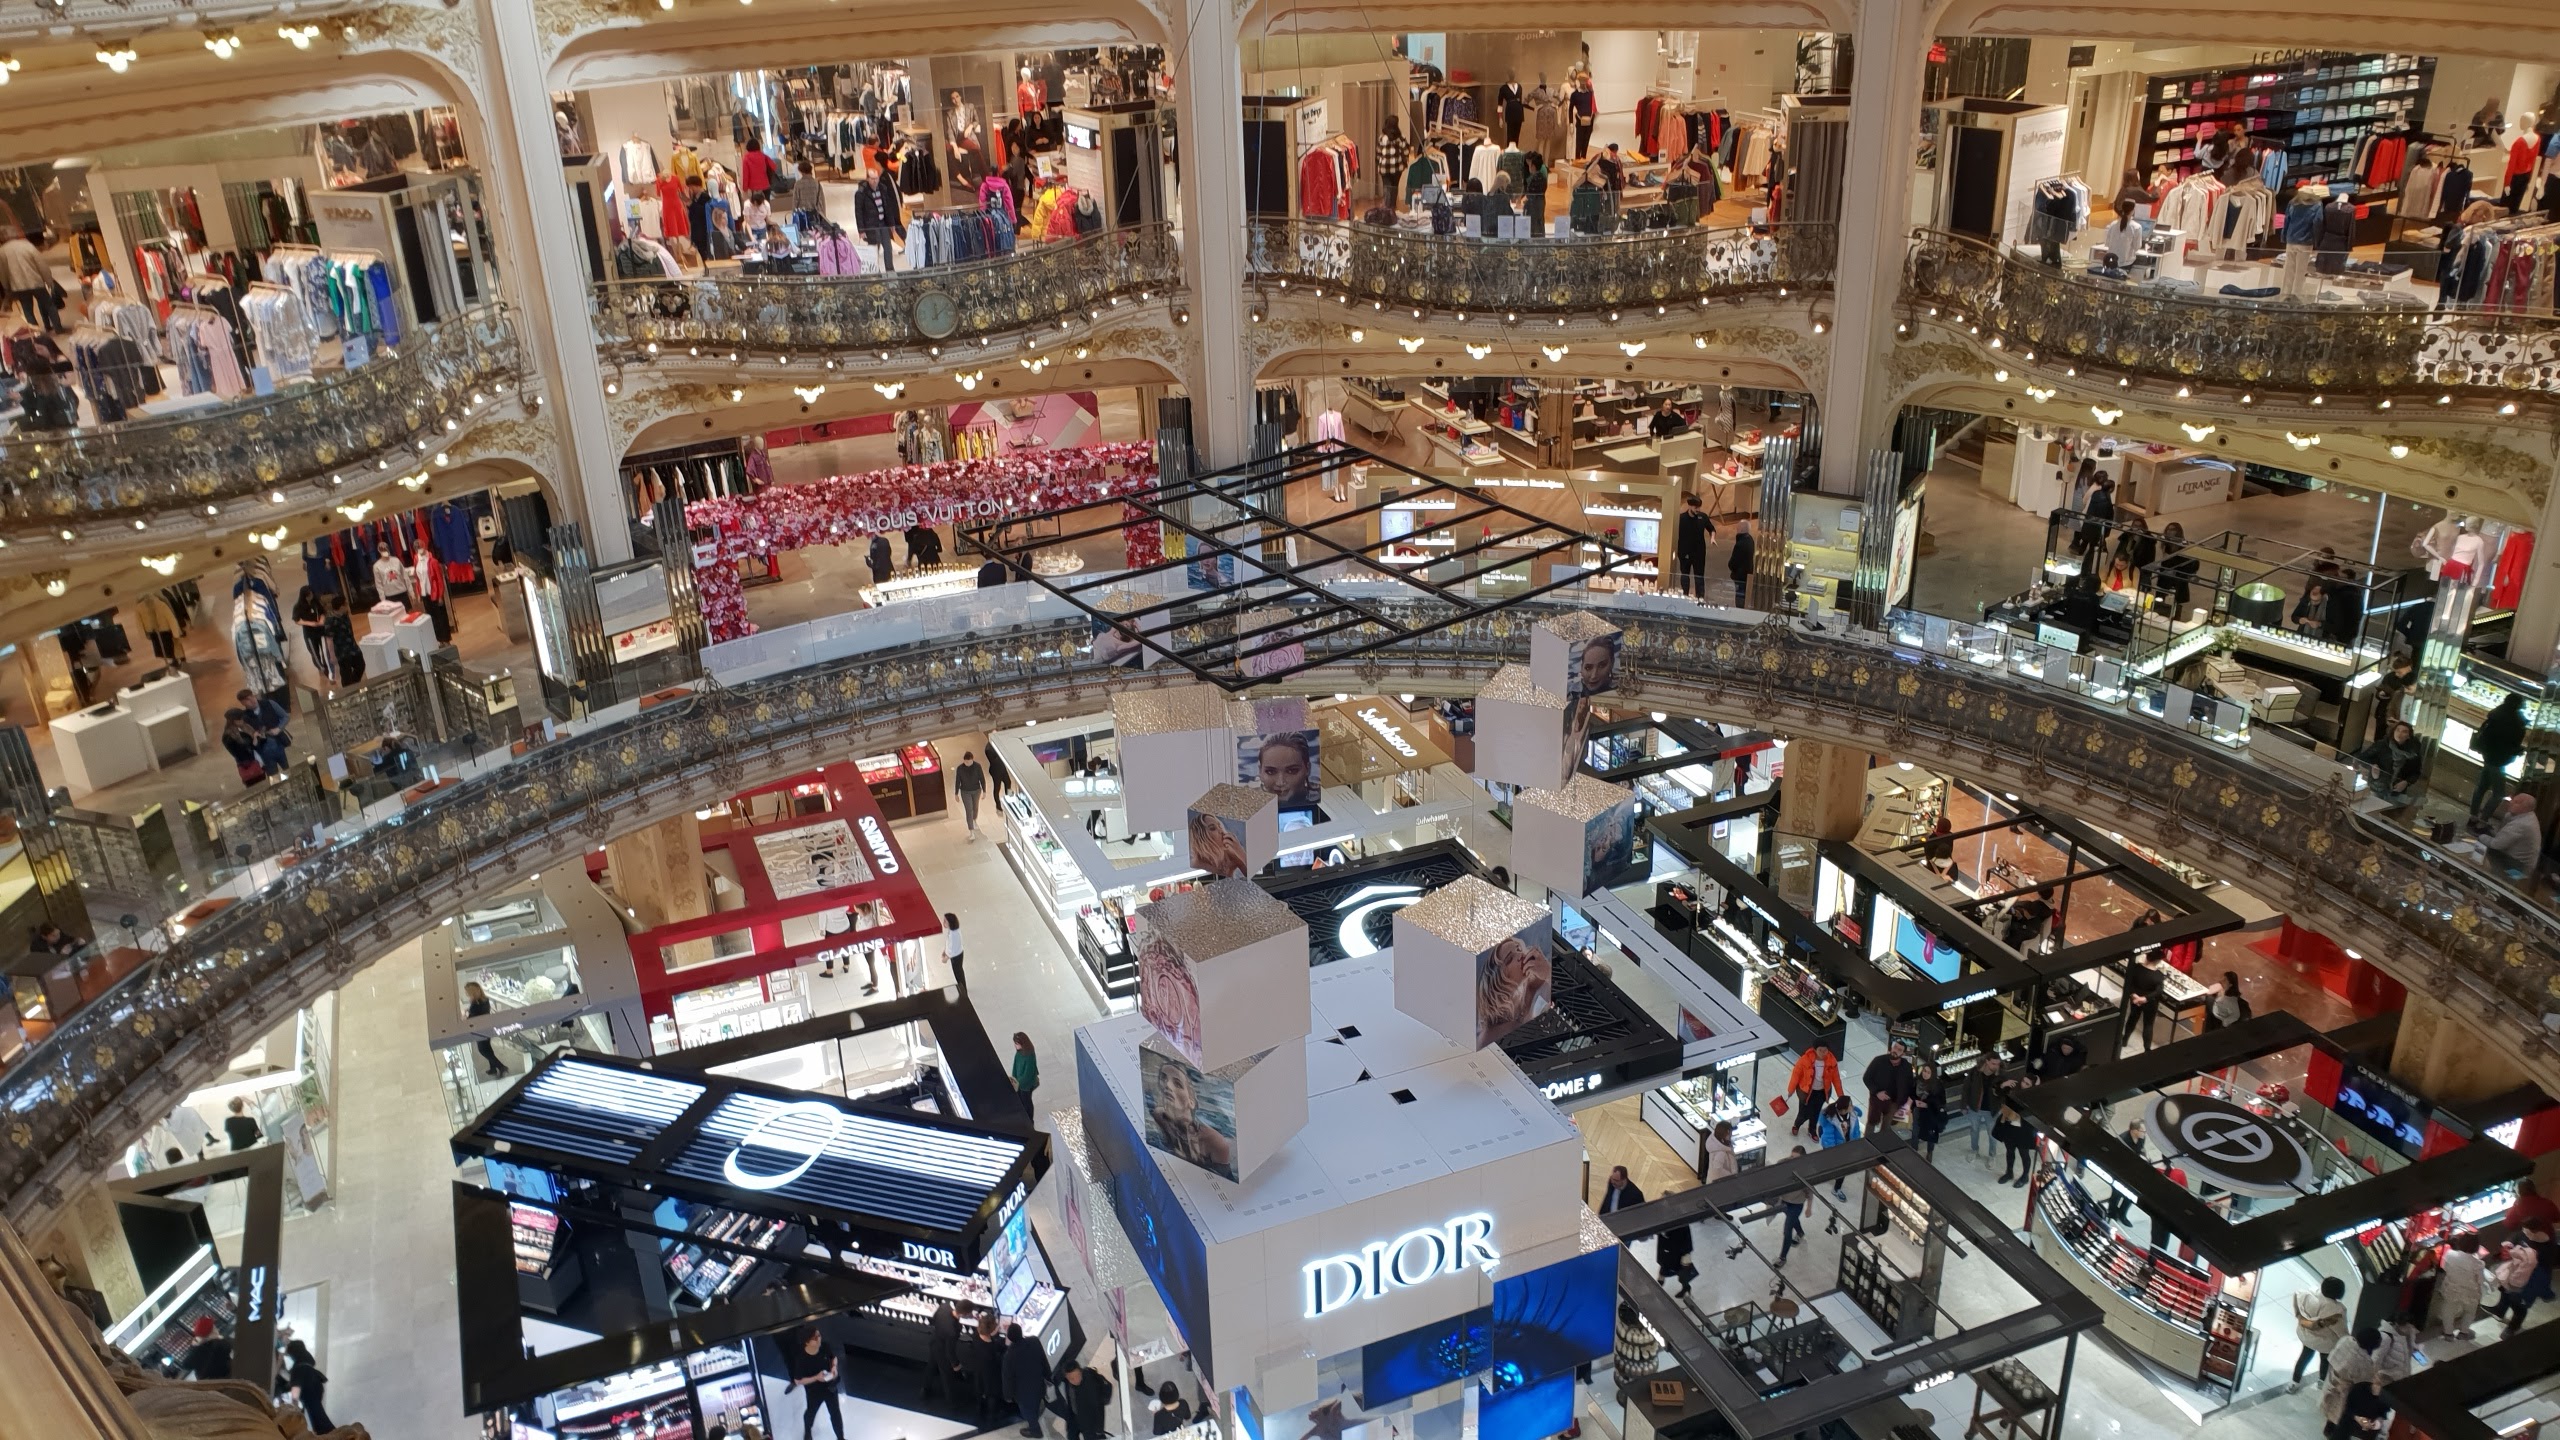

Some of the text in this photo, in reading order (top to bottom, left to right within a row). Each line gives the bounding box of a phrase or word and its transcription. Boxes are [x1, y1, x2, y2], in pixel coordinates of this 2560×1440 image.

[865, 498, 1004, 533] LOUIS VUITTON
[858, 815, 899, 874] CLARINS
[817, 937, 885, 962] CLARINS
[998, 1181, 1027, 1228] DIOR
[902, 1240, 957, 1269] DIOR
[1302, 1211, 1501, 1320] DIOR
[1914, 1379, 1929, 1393] LE
